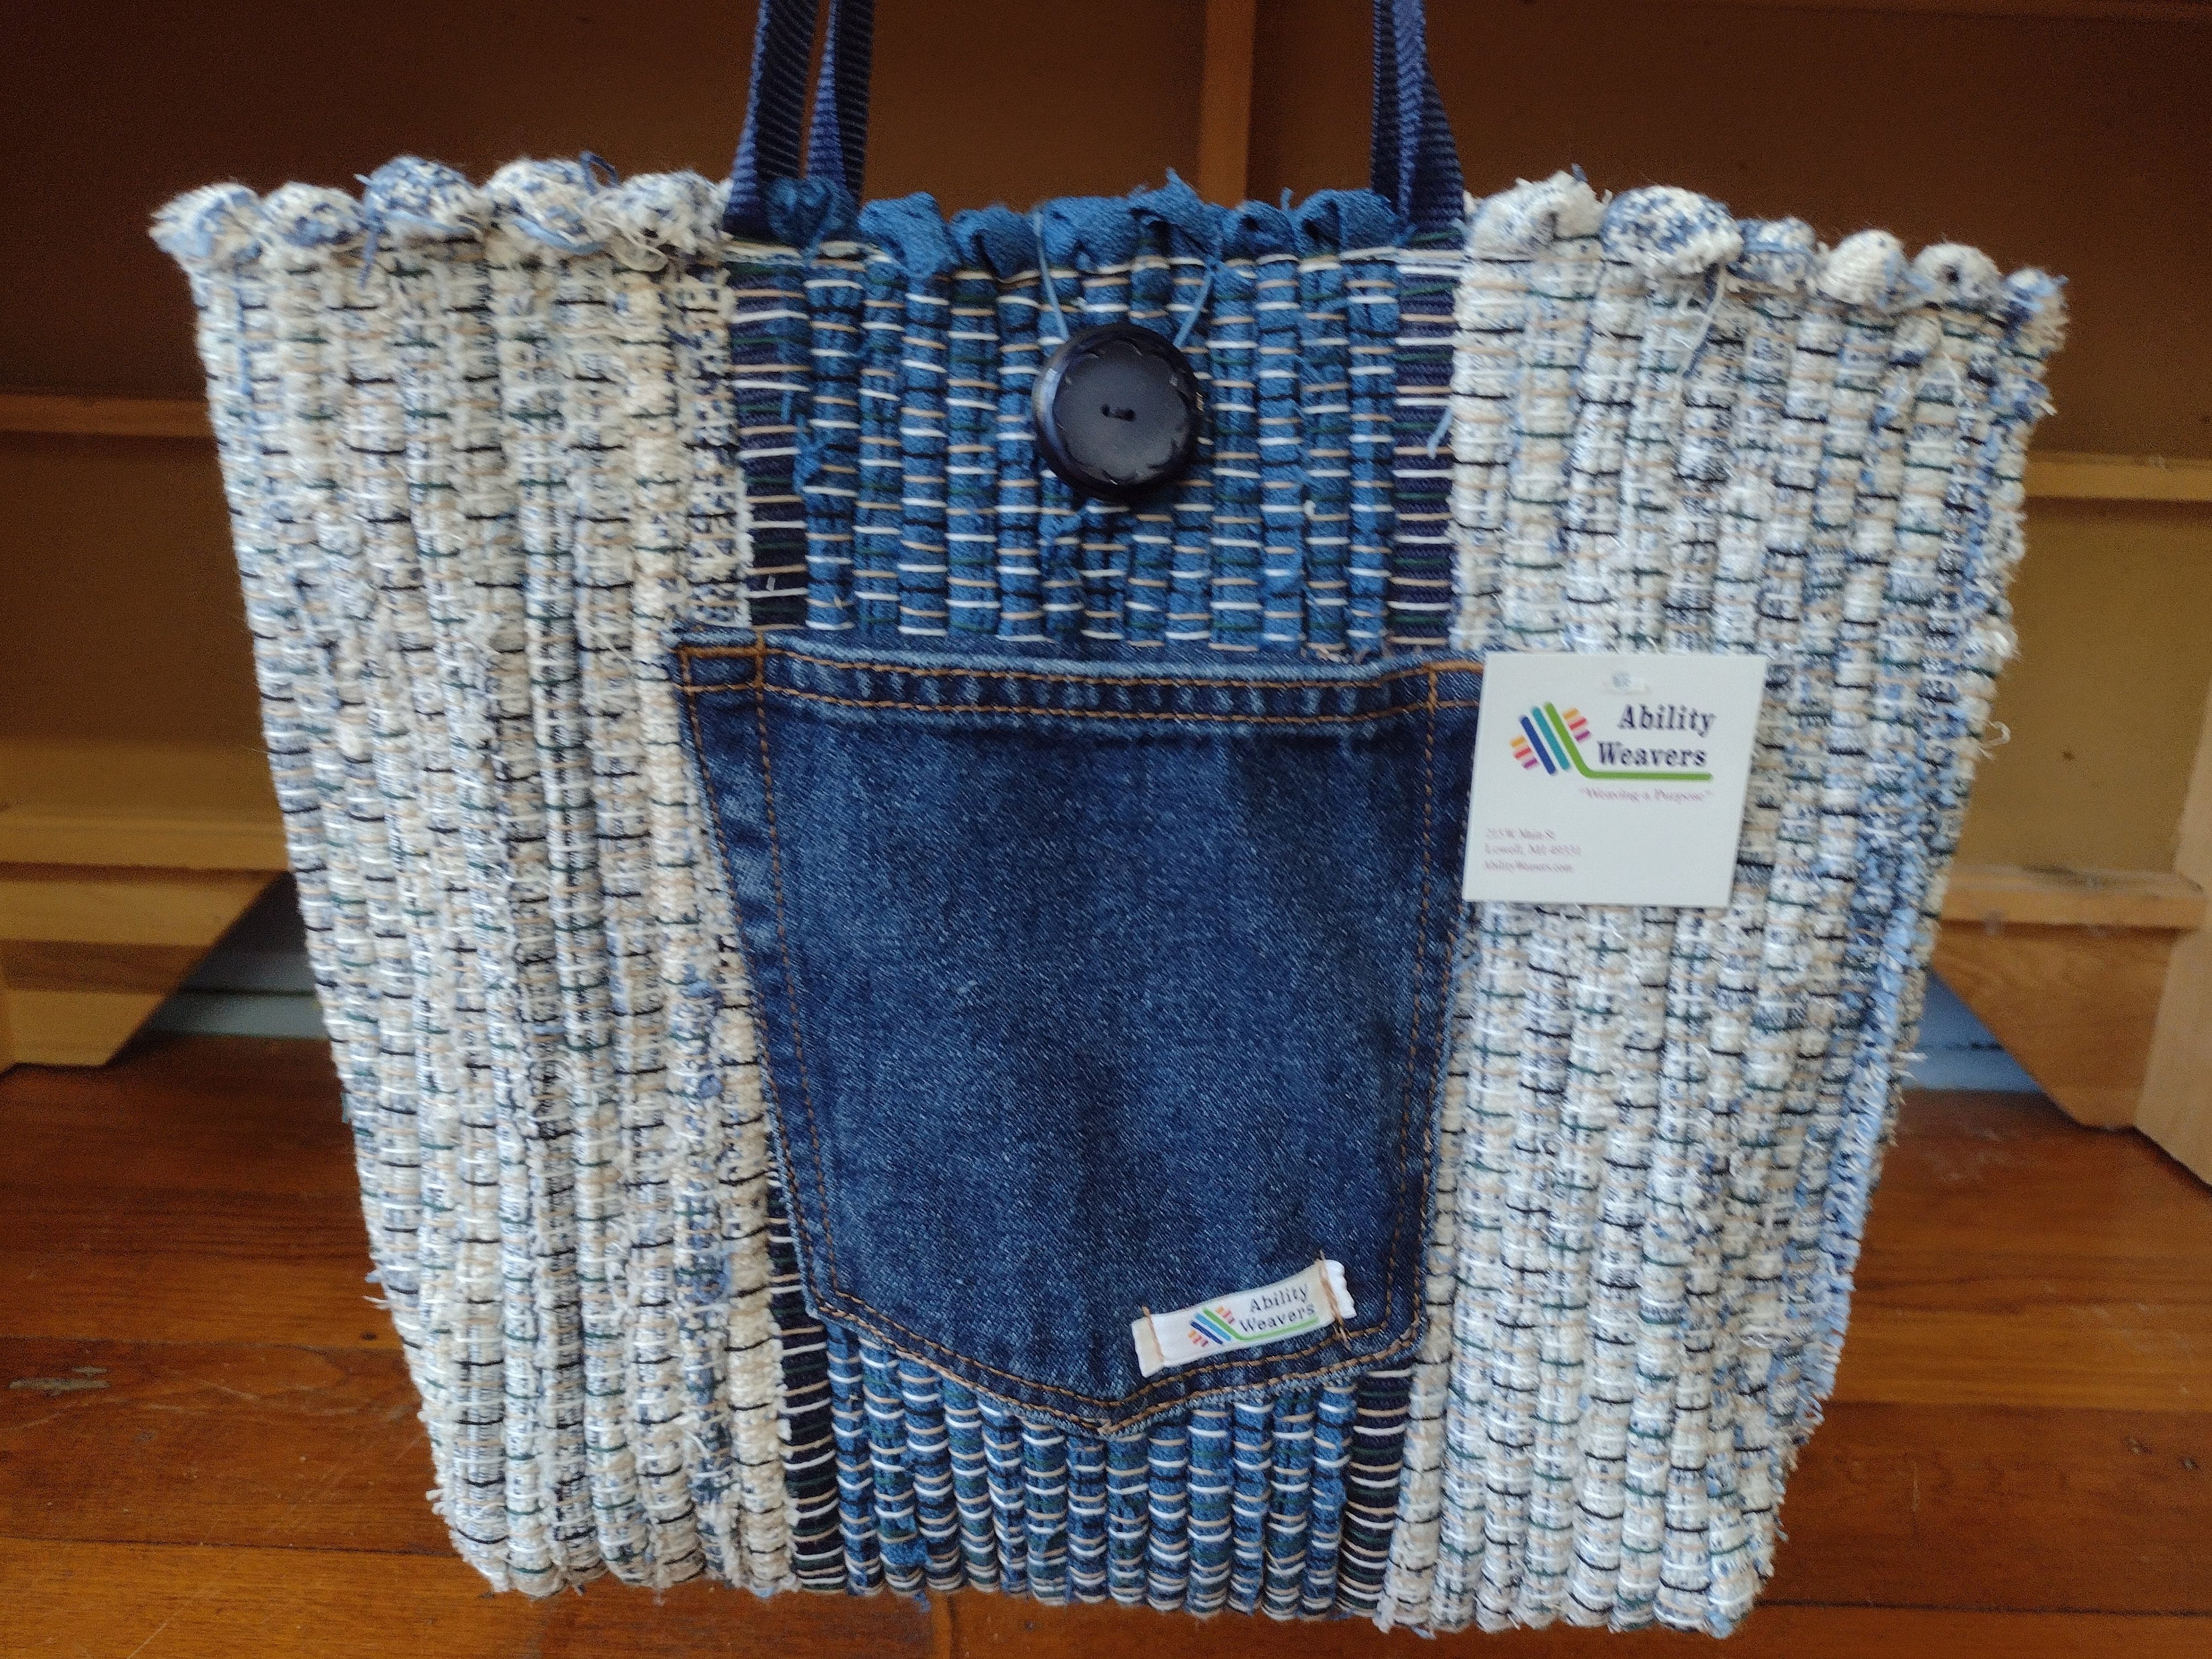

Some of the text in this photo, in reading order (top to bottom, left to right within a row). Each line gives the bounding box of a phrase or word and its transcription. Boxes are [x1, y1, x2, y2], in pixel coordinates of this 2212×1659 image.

[1618, 703, 1717, 737] Ability
[1597, 741, 1707, 767] Weavers
[1250, 1283, 1309, 1313] Ability
[1240, 1302, 1315, 1332] Weavers
